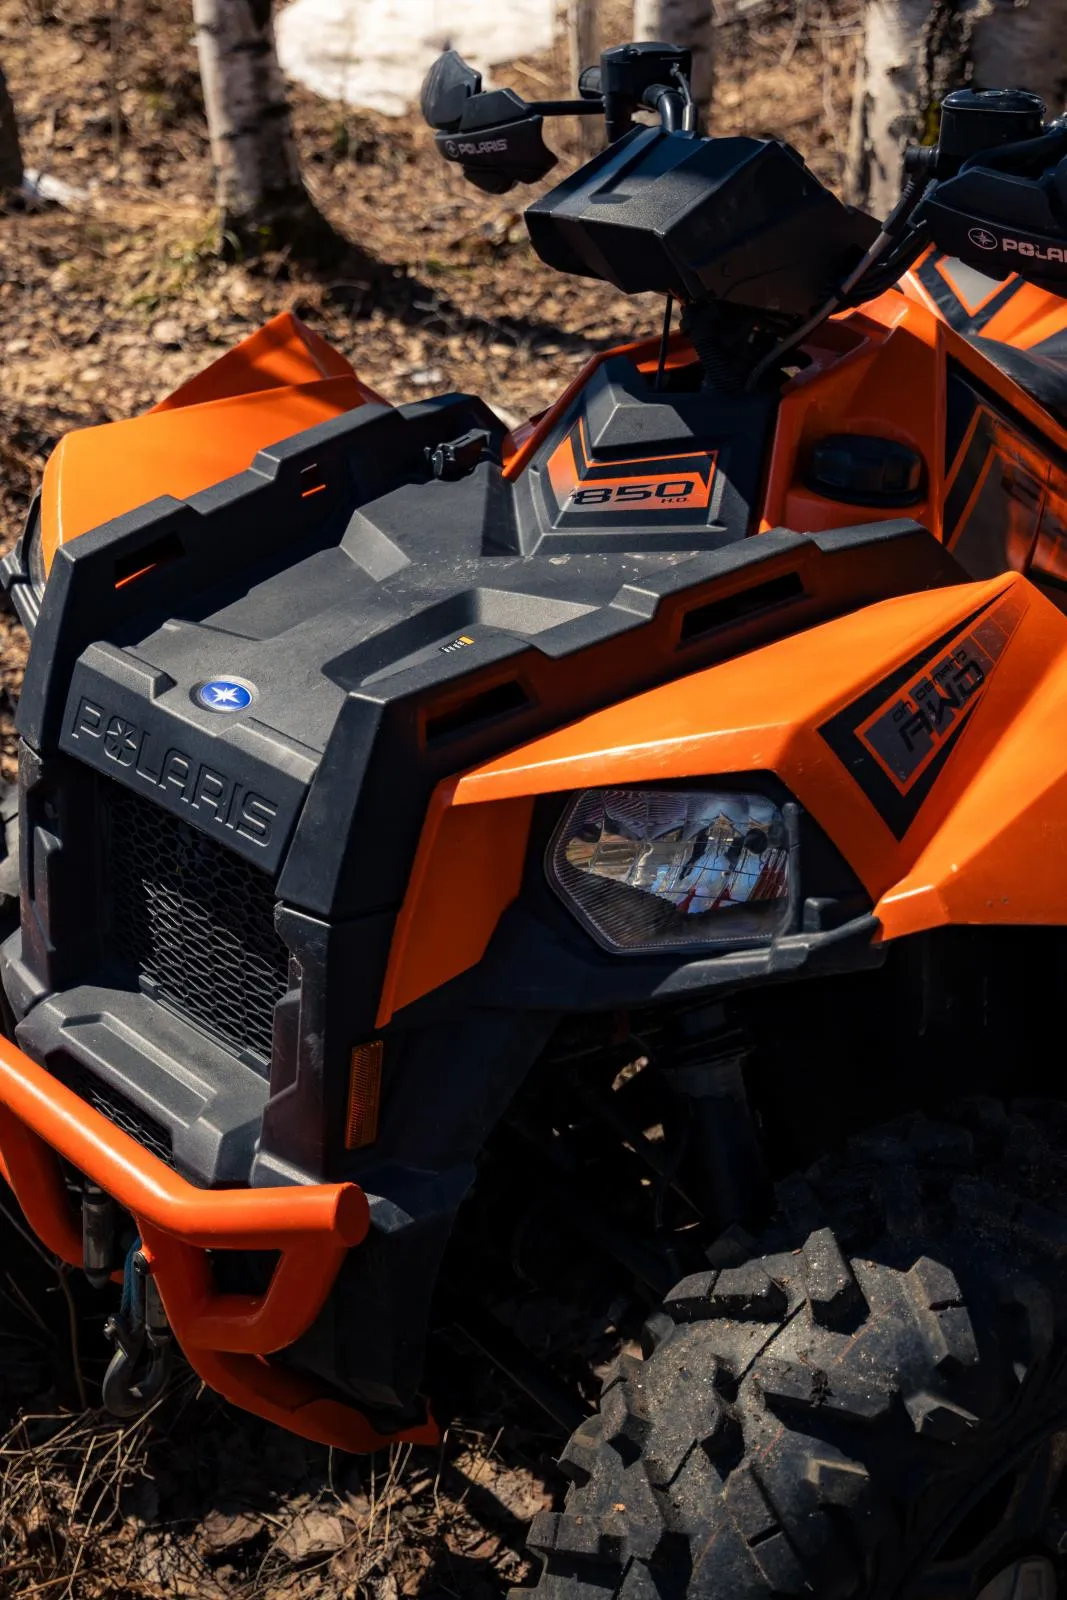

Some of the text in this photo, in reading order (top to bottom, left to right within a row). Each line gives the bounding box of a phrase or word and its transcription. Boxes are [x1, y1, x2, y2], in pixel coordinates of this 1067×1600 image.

[459, 140, 507, 155] POLARIS
[1003, 239, 1067, 262] POLA
[573, 481, 694, 504] 850
[899, 661, 984, 751] AWD
[72, 697, 278, 847] POLARIS
